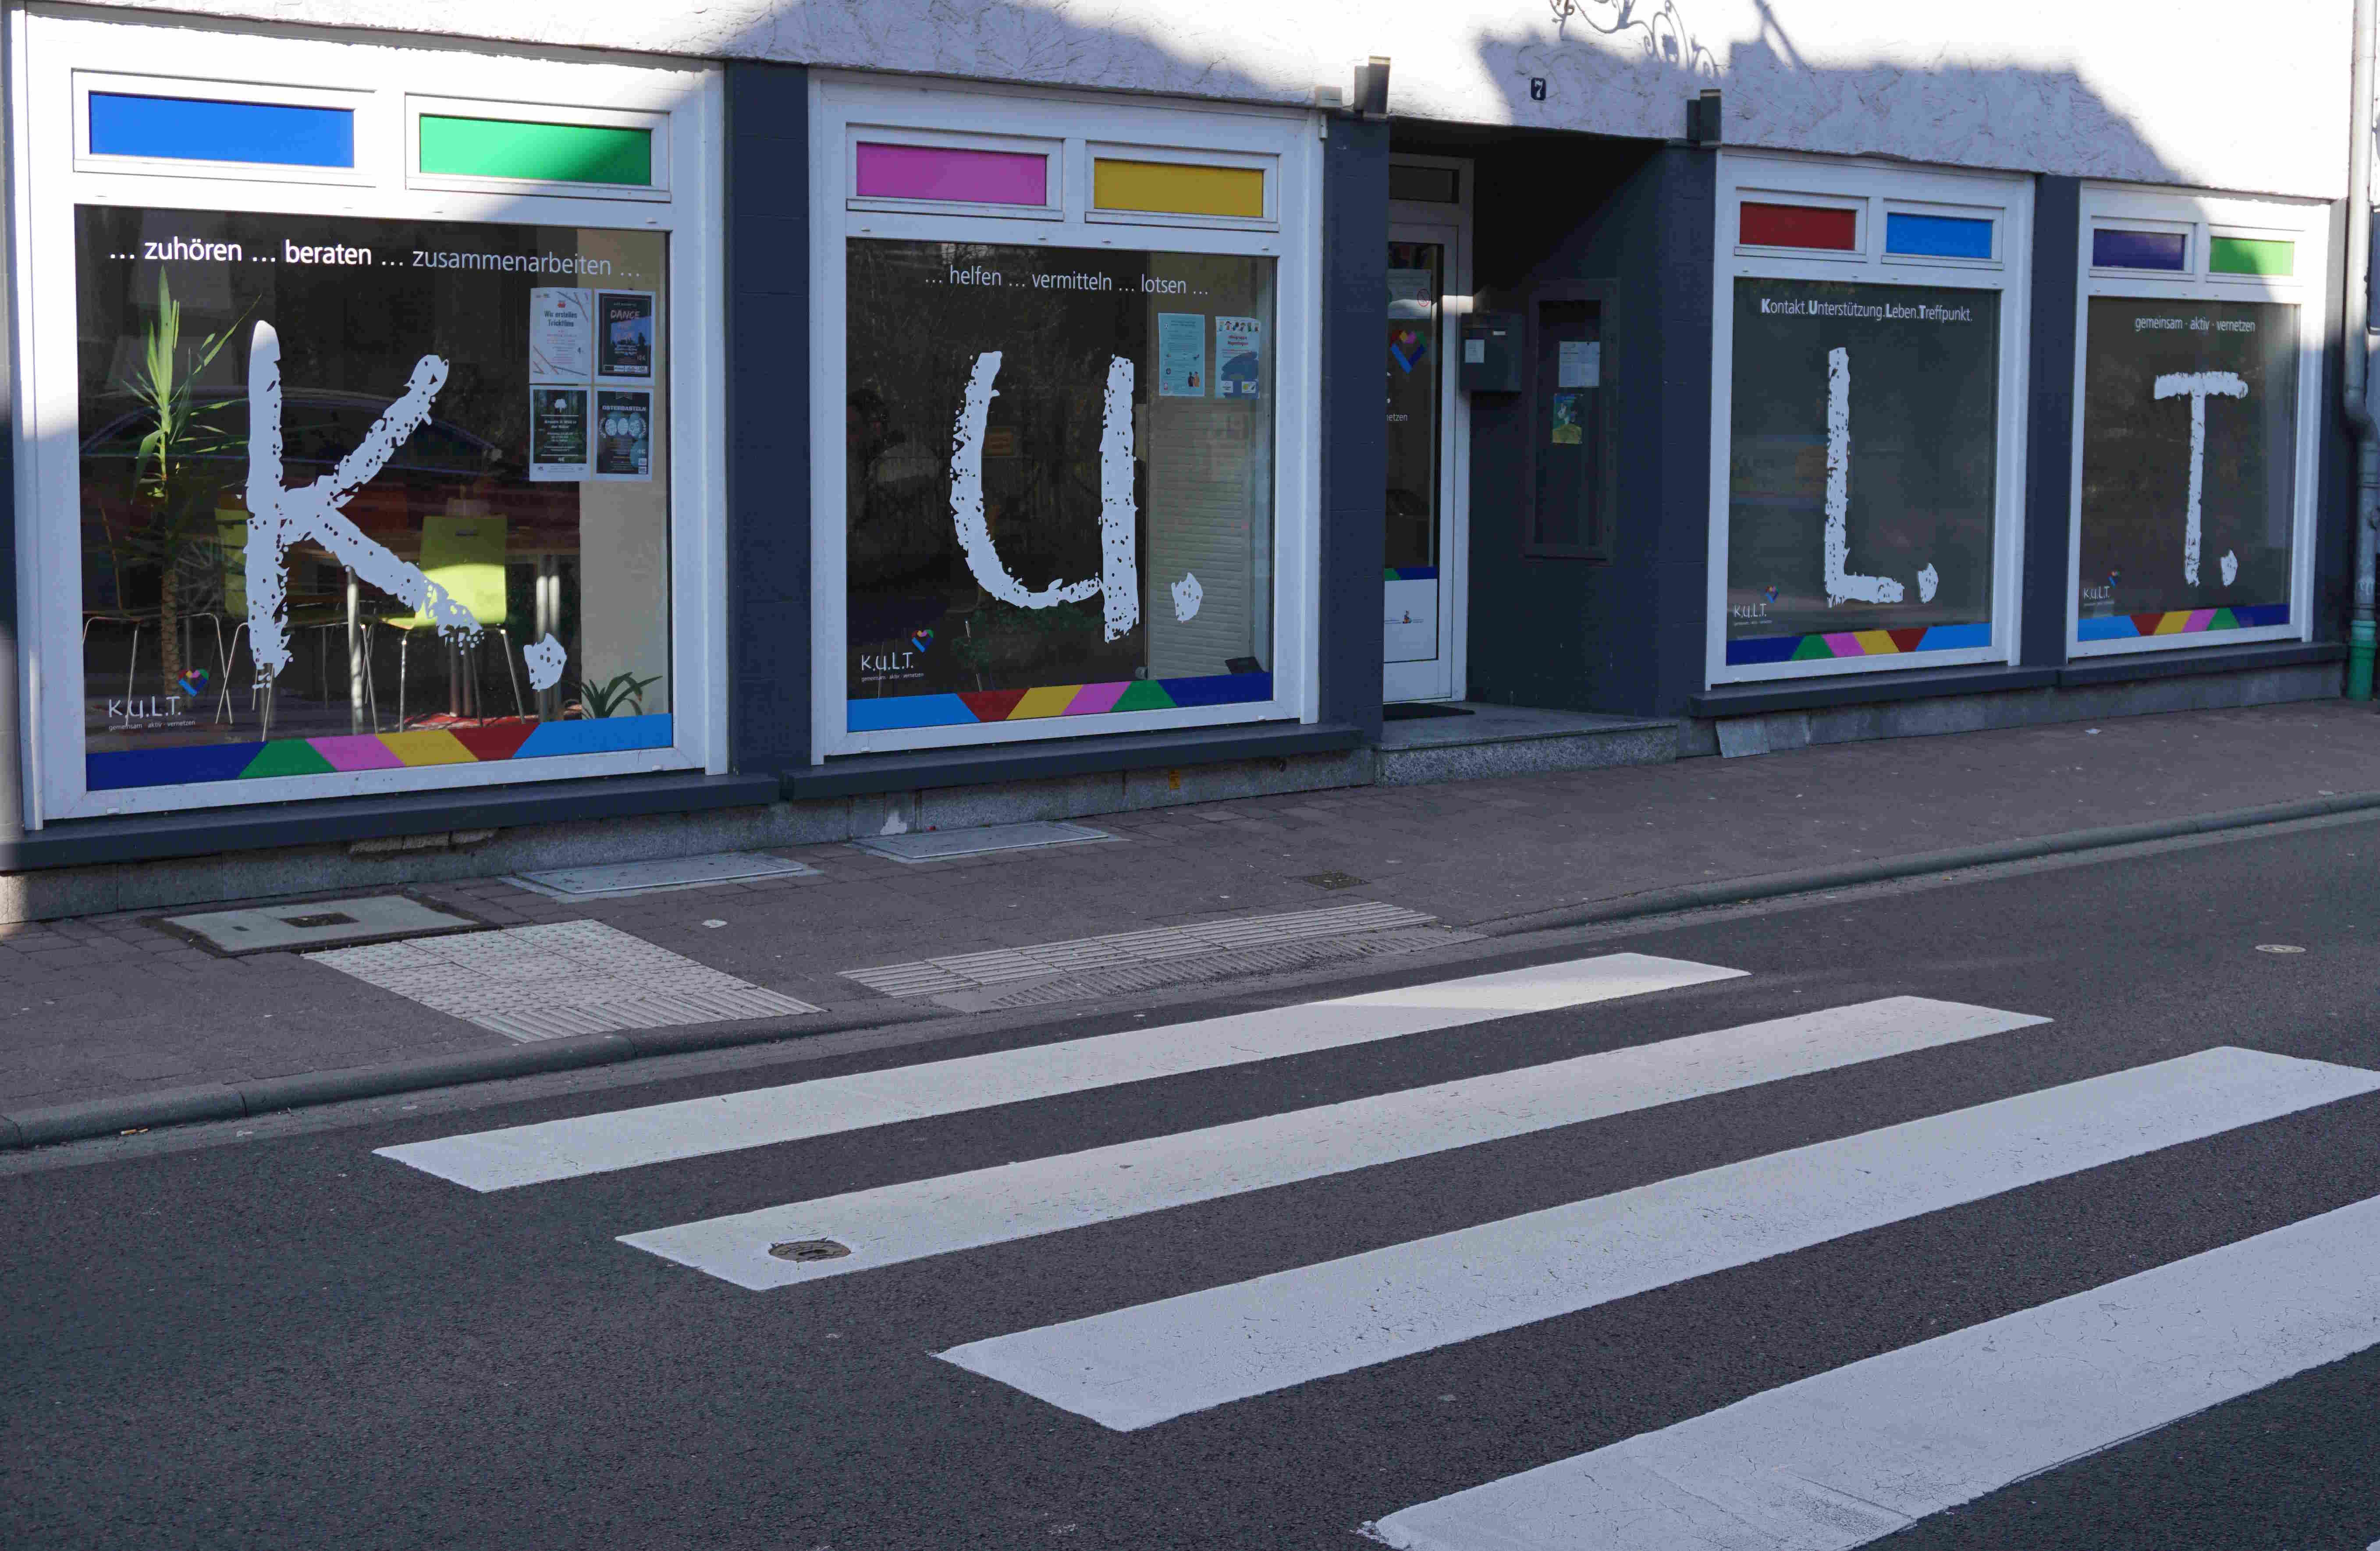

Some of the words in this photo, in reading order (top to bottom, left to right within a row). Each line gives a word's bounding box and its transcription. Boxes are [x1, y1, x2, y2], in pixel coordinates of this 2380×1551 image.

[1535, 80, 1543, 98] 7
[144, 236, 242, 262] zuhören
[285, 239, 372, 265] beraten
[412, 249, 612, 277] zusammenarbeiten
[950, 265, 1002, 286] helfen
[1032, 270, 1112, 291] vermitteln
[1141, 273, 1186, 294] lotsen
[610, 309, 640, 320] DANCE
[2135, 315, 2183, 332] gemeinsam
[2190, 315, 2210, 330] aktiv
[2216, 319, 2256, 333] vernetzen
[861, 651, 914, 671] K.U.L.T.
[108, 696, 181, 719] K.U.L.T.
[109, 724, 142, 732] gemeinsam
